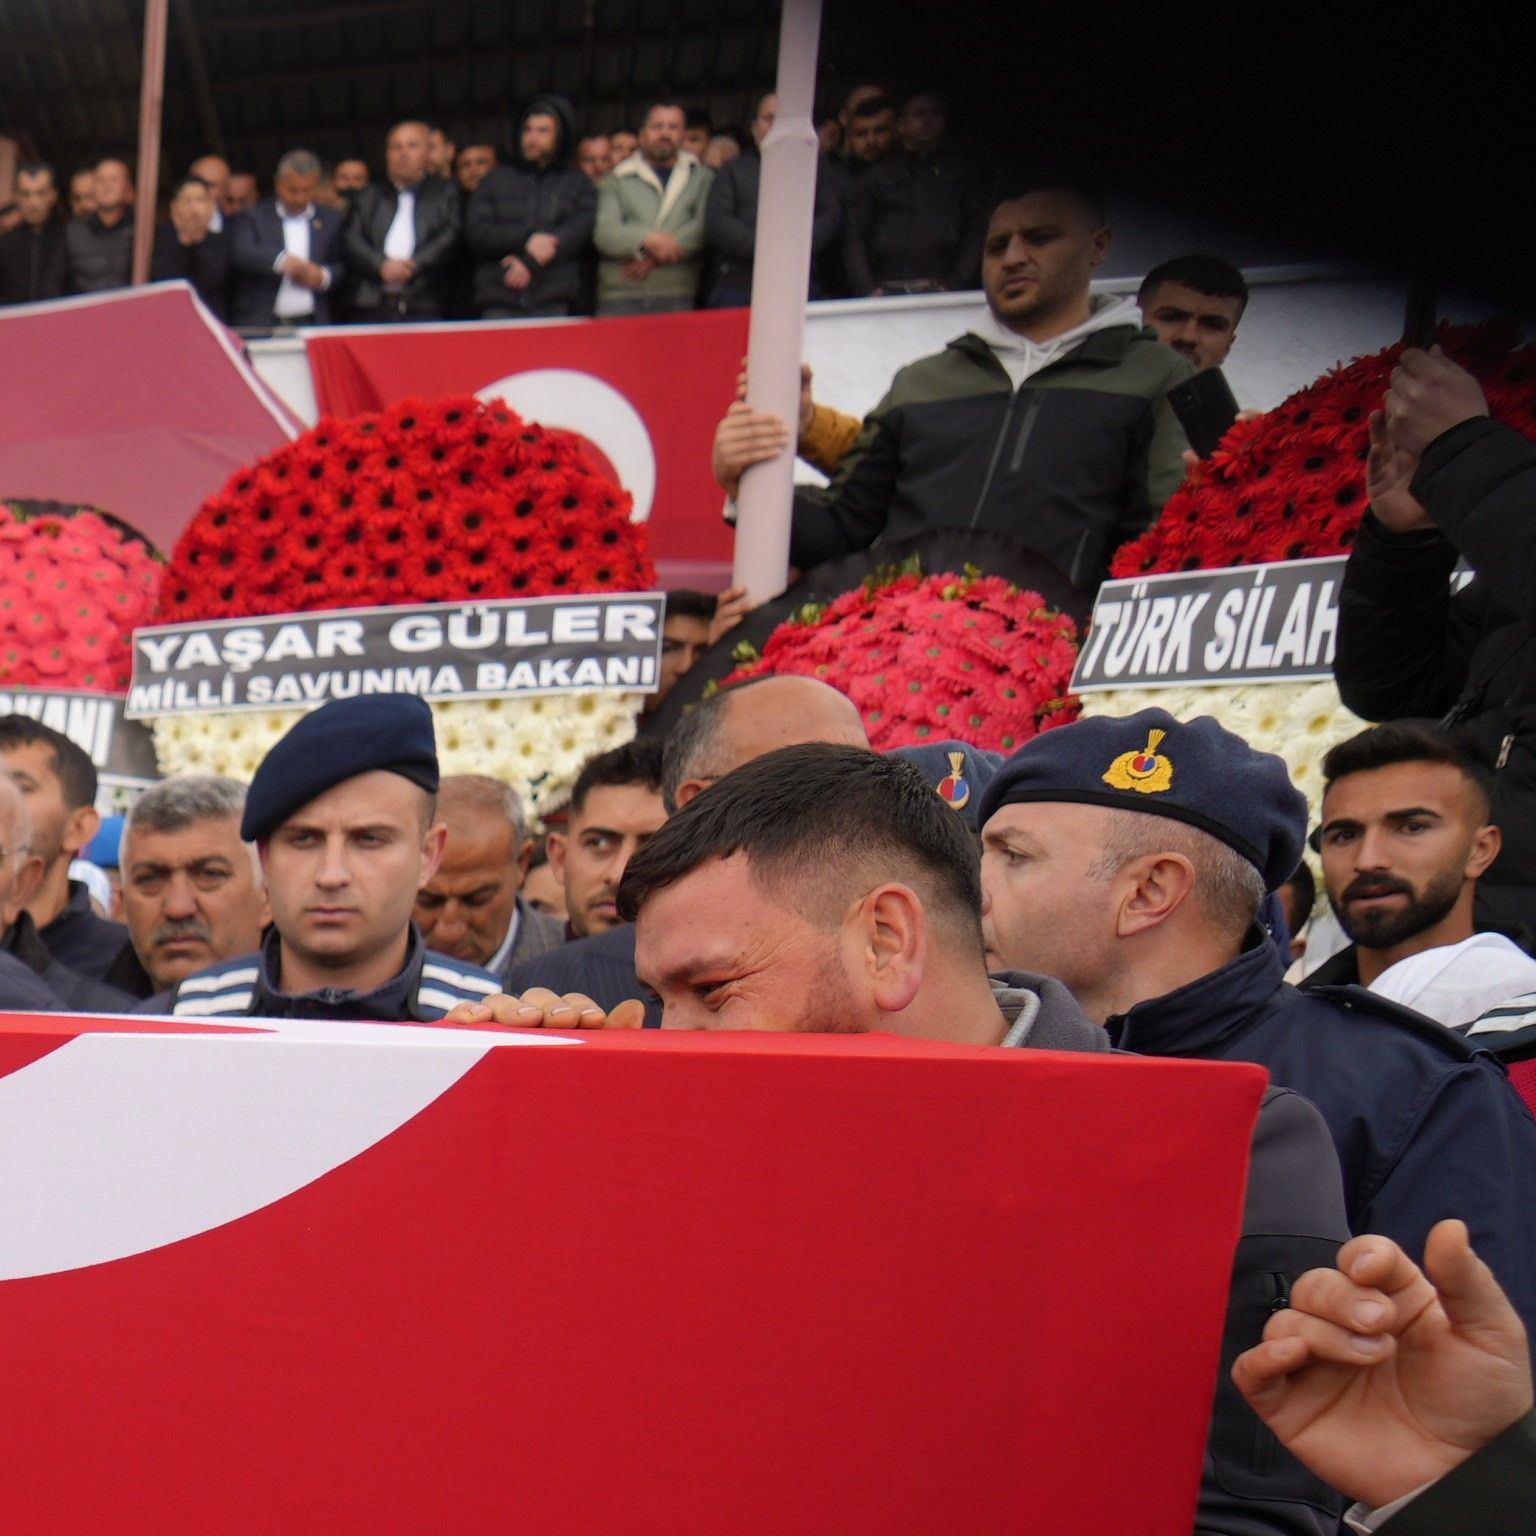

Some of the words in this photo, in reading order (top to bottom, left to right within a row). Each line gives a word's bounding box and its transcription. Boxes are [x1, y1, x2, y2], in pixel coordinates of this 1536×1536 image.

[137, 621, 365, 673] YAŞAR
[389, 604, 656, 652] GÜLER
[1081, 583, 1210, 678] TÜRK
[130, 671, 233, 711] MİLLİ
[247, 663, 462, 704] SAVUNMA
[477, 656, 655, 690] BAKANI
